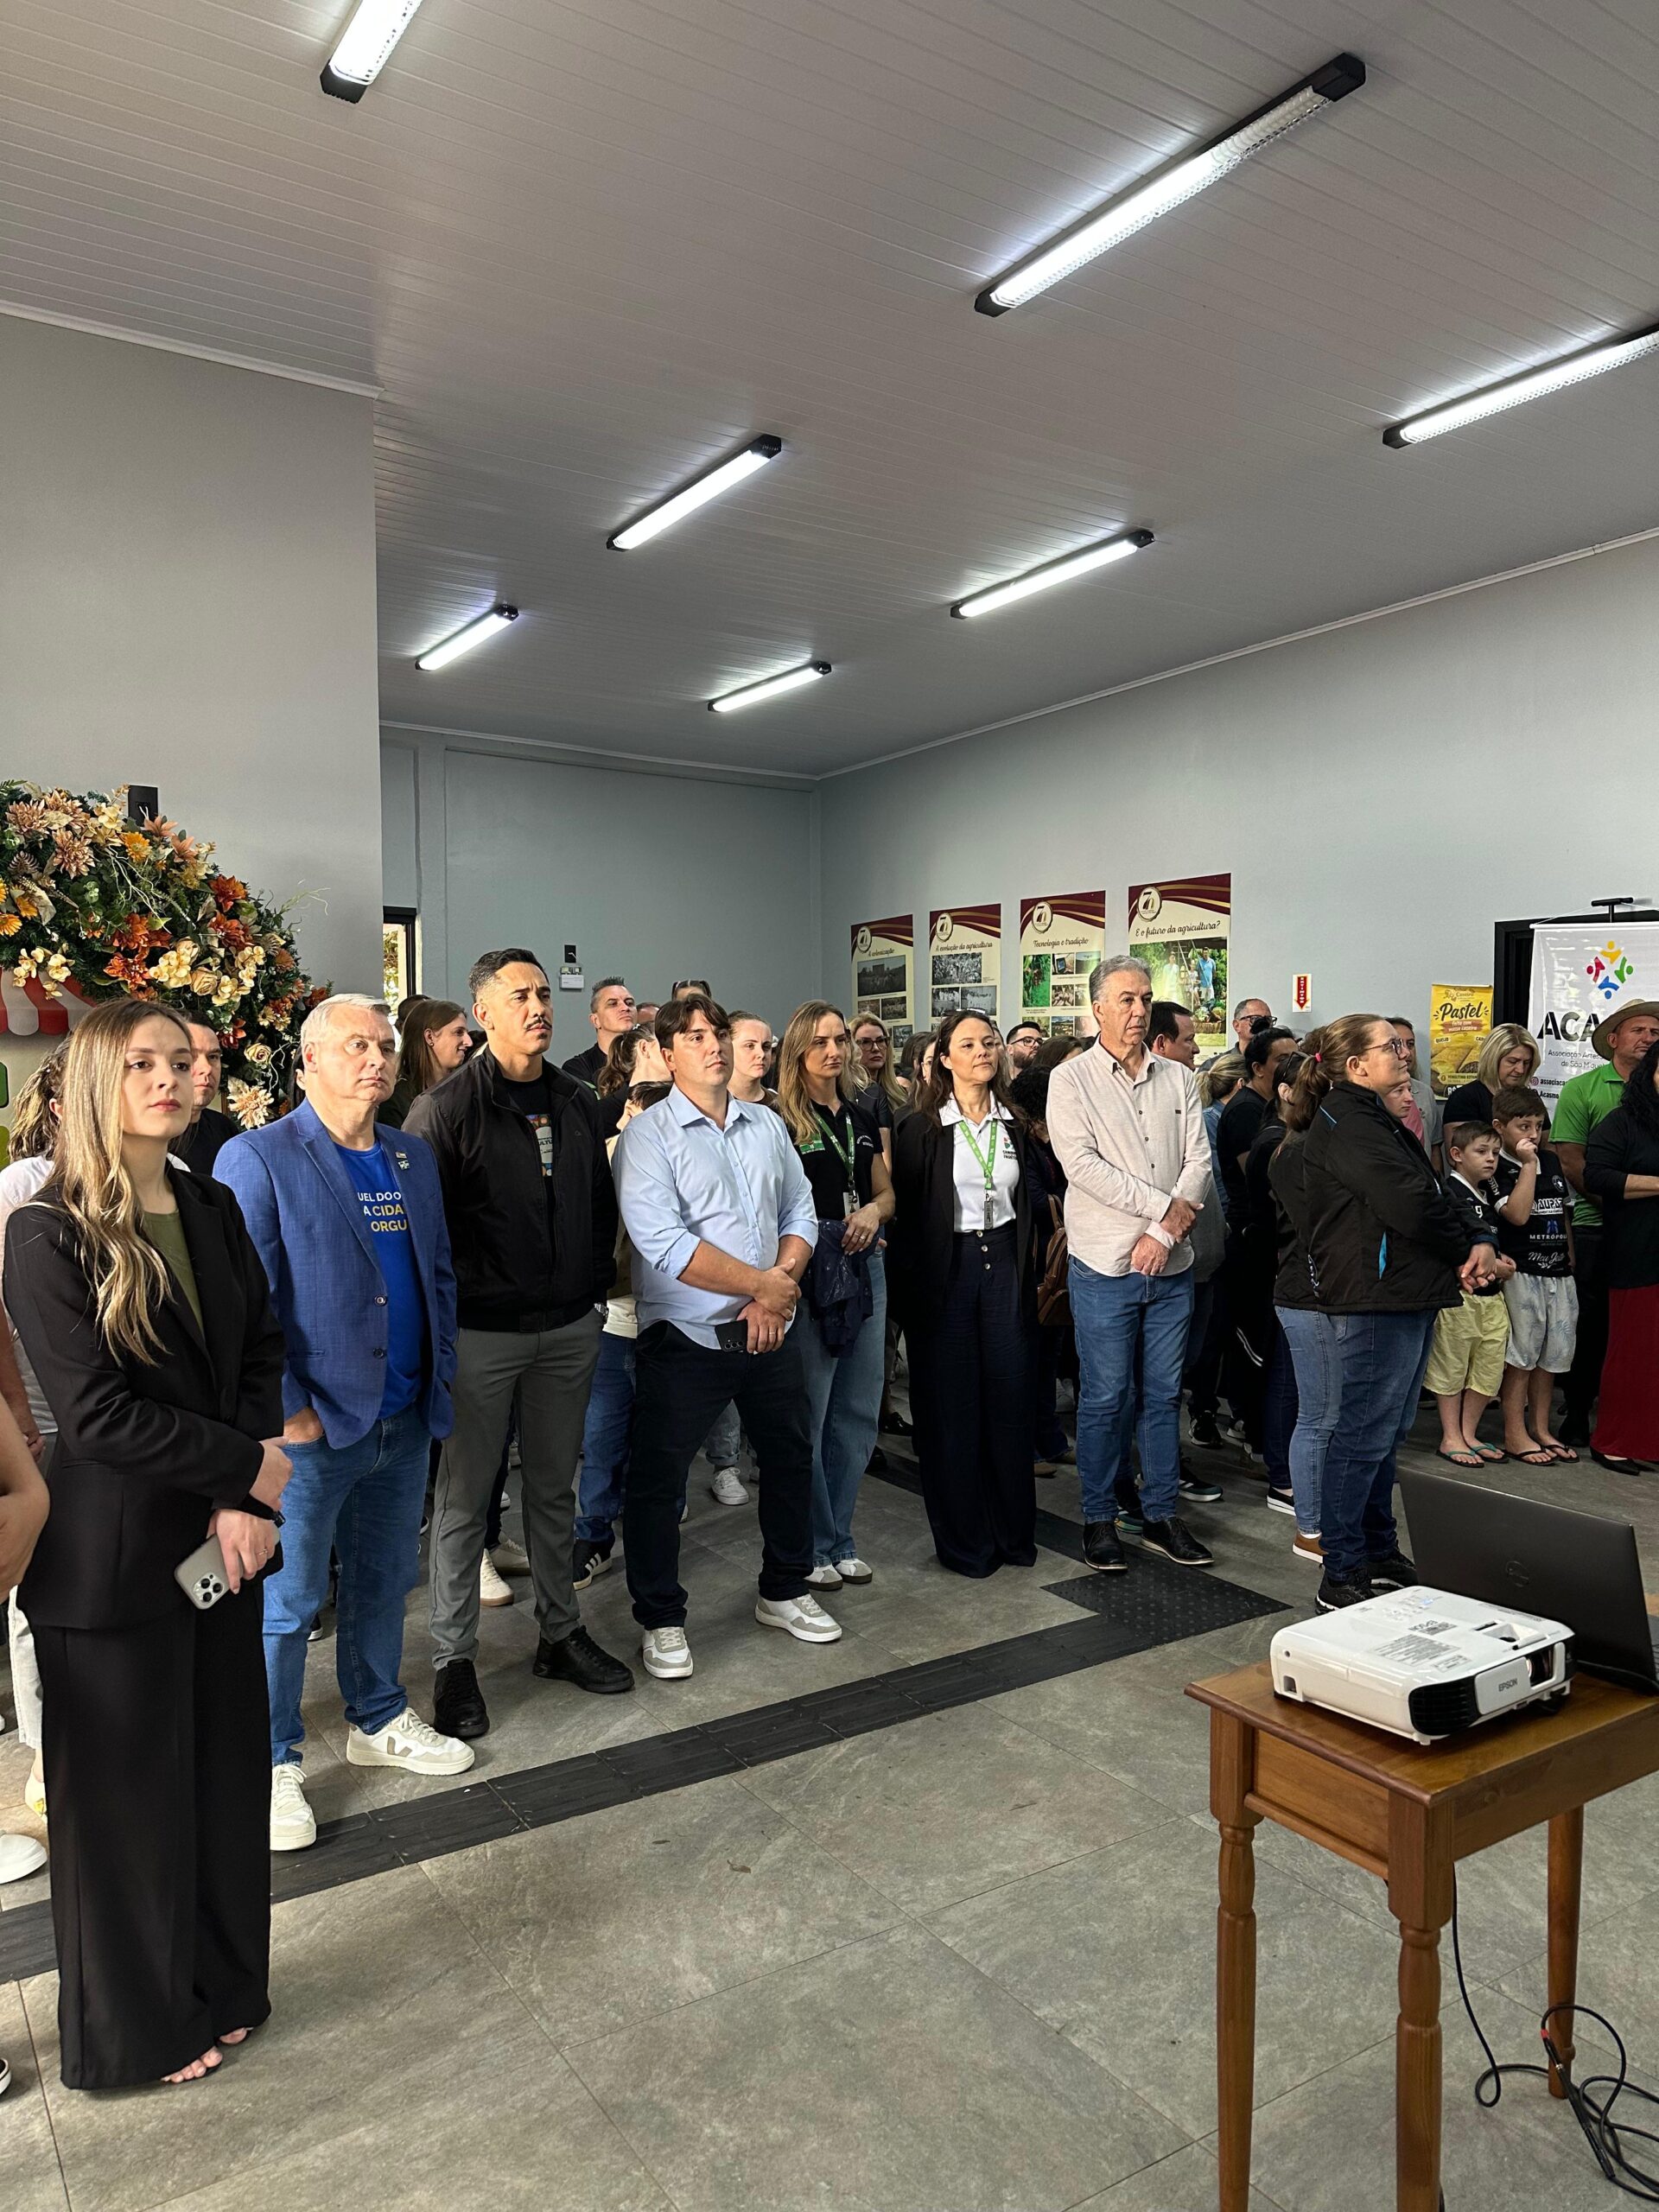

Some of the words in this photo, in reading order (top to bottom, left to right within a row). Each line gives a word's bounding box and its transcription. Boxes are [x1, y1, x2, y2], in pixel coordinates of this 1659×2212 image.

[1146, 926, 1166, 938] futuro
[1167, 925, 1176, 934] da
[1177, 920, 1221, 935] agricultura?
[966, 940, 993, 951] agricultura
[1033, 938, 1060, 949] Tecnologia
[1065, 937, 1089, 946] tradição
[1440, 1001, 1484, 1021] Pastel
[372, 1204, 404, 1217] CIDA
[371, 1219, 408, 1232] ORGU
[1498, 1678, 1518, 1692] EPSON
